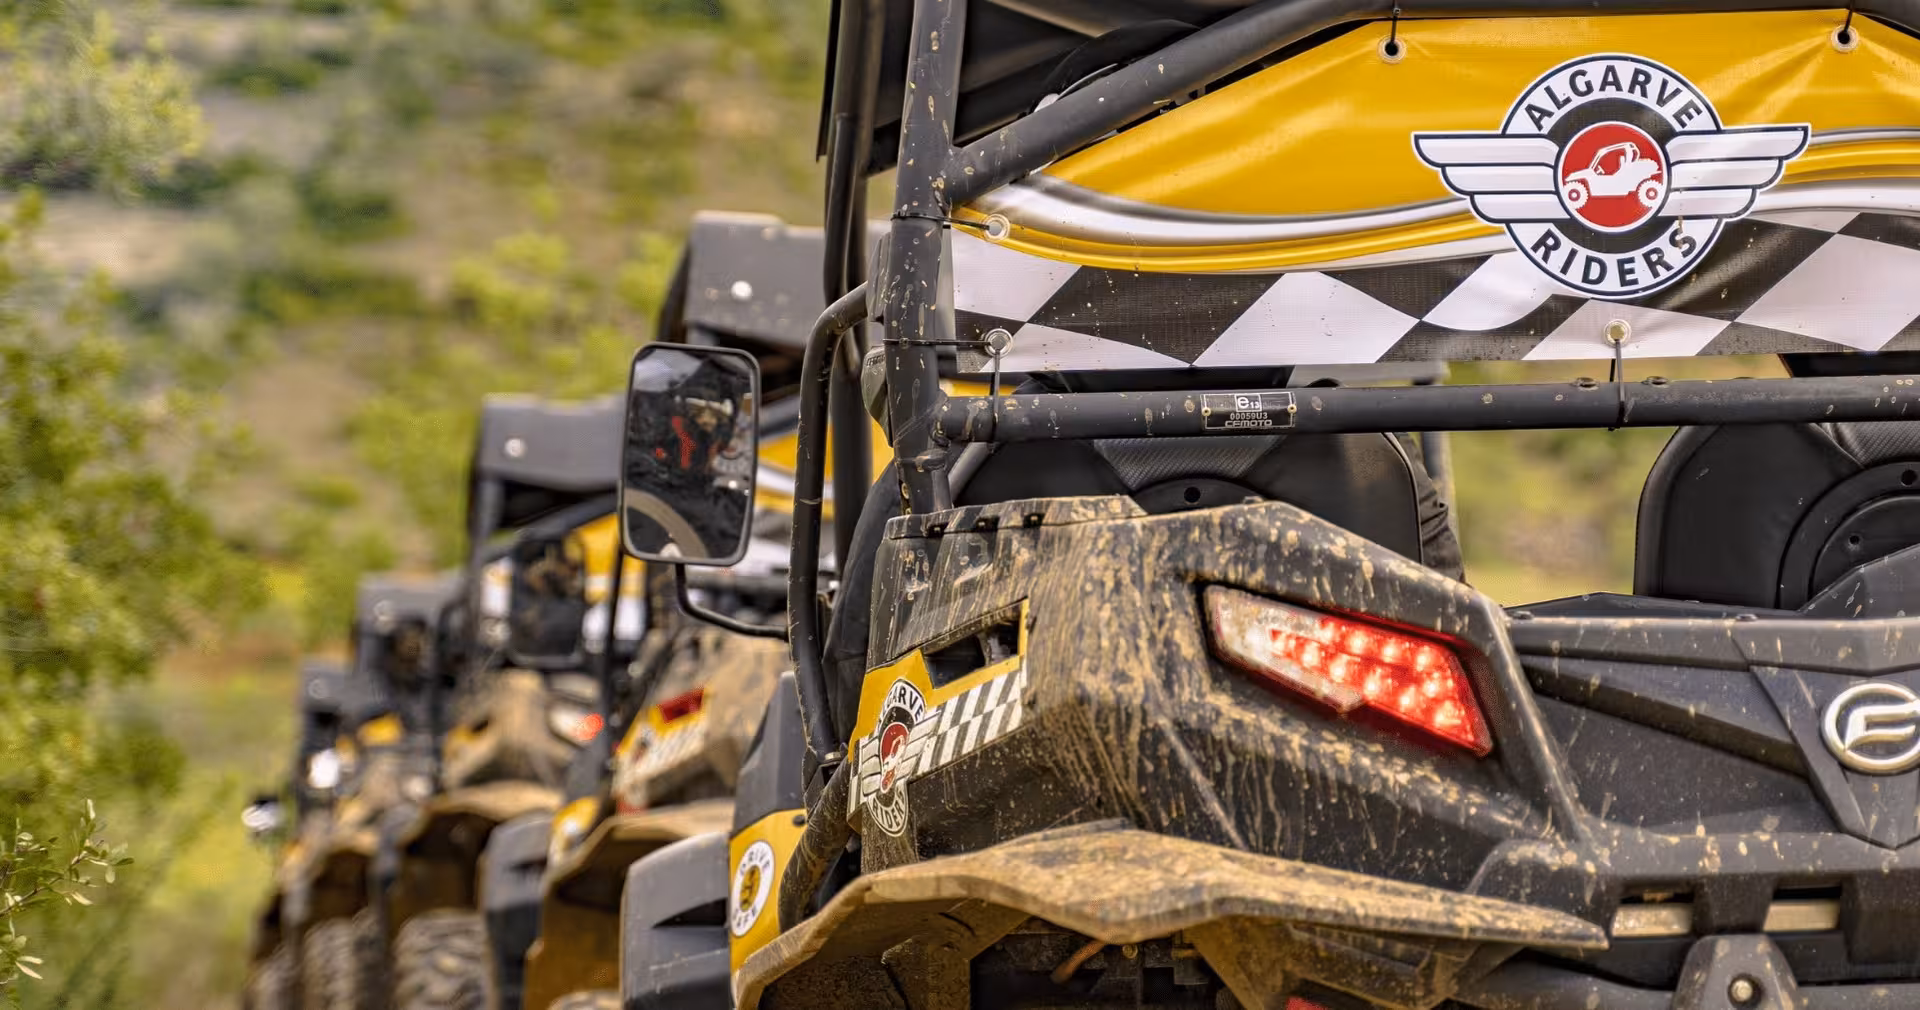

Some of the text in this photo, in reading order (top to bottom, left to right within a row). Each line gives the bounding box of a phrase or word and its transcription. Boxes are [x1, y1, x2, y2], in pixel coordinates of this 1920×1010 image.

[1524, 64, 1703, 131] ALGARVE
[1530, 227, 1697, 287] RIDERS
[1225, 420, 1272, 428] CFMOTO
[872, 786, 905, 829] RIDERS
